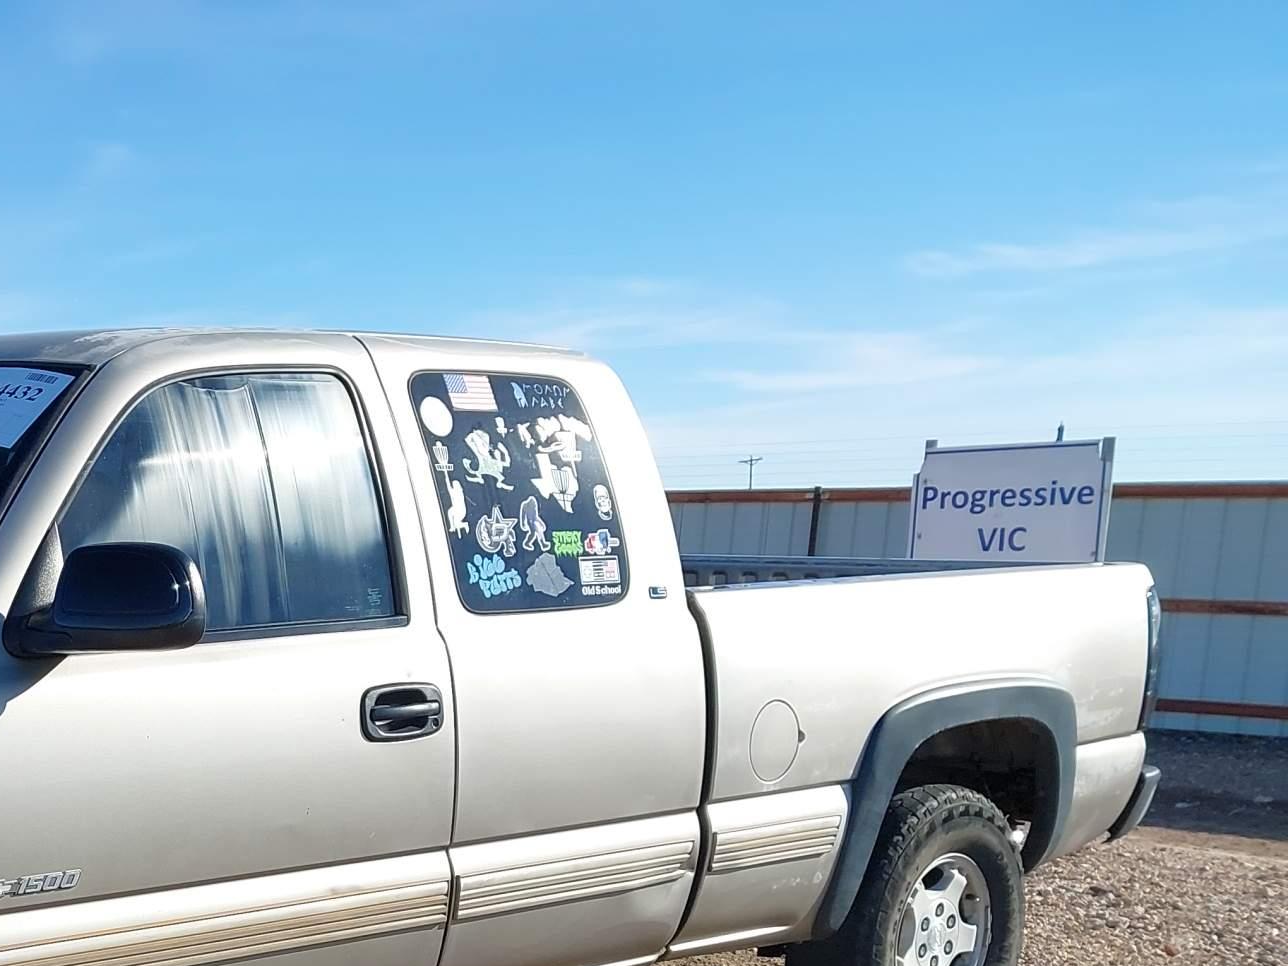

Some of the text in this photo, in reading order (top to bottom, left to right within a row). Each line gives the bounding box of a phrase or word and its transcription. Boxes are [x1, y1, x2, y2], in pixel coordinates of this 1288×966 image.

[922, 480, 1095, 514] Progressive
[977, 526, 1028, 552] VIC
[582, 585, 622, 596] Old School
[18, 869, 81, 895] 1500
